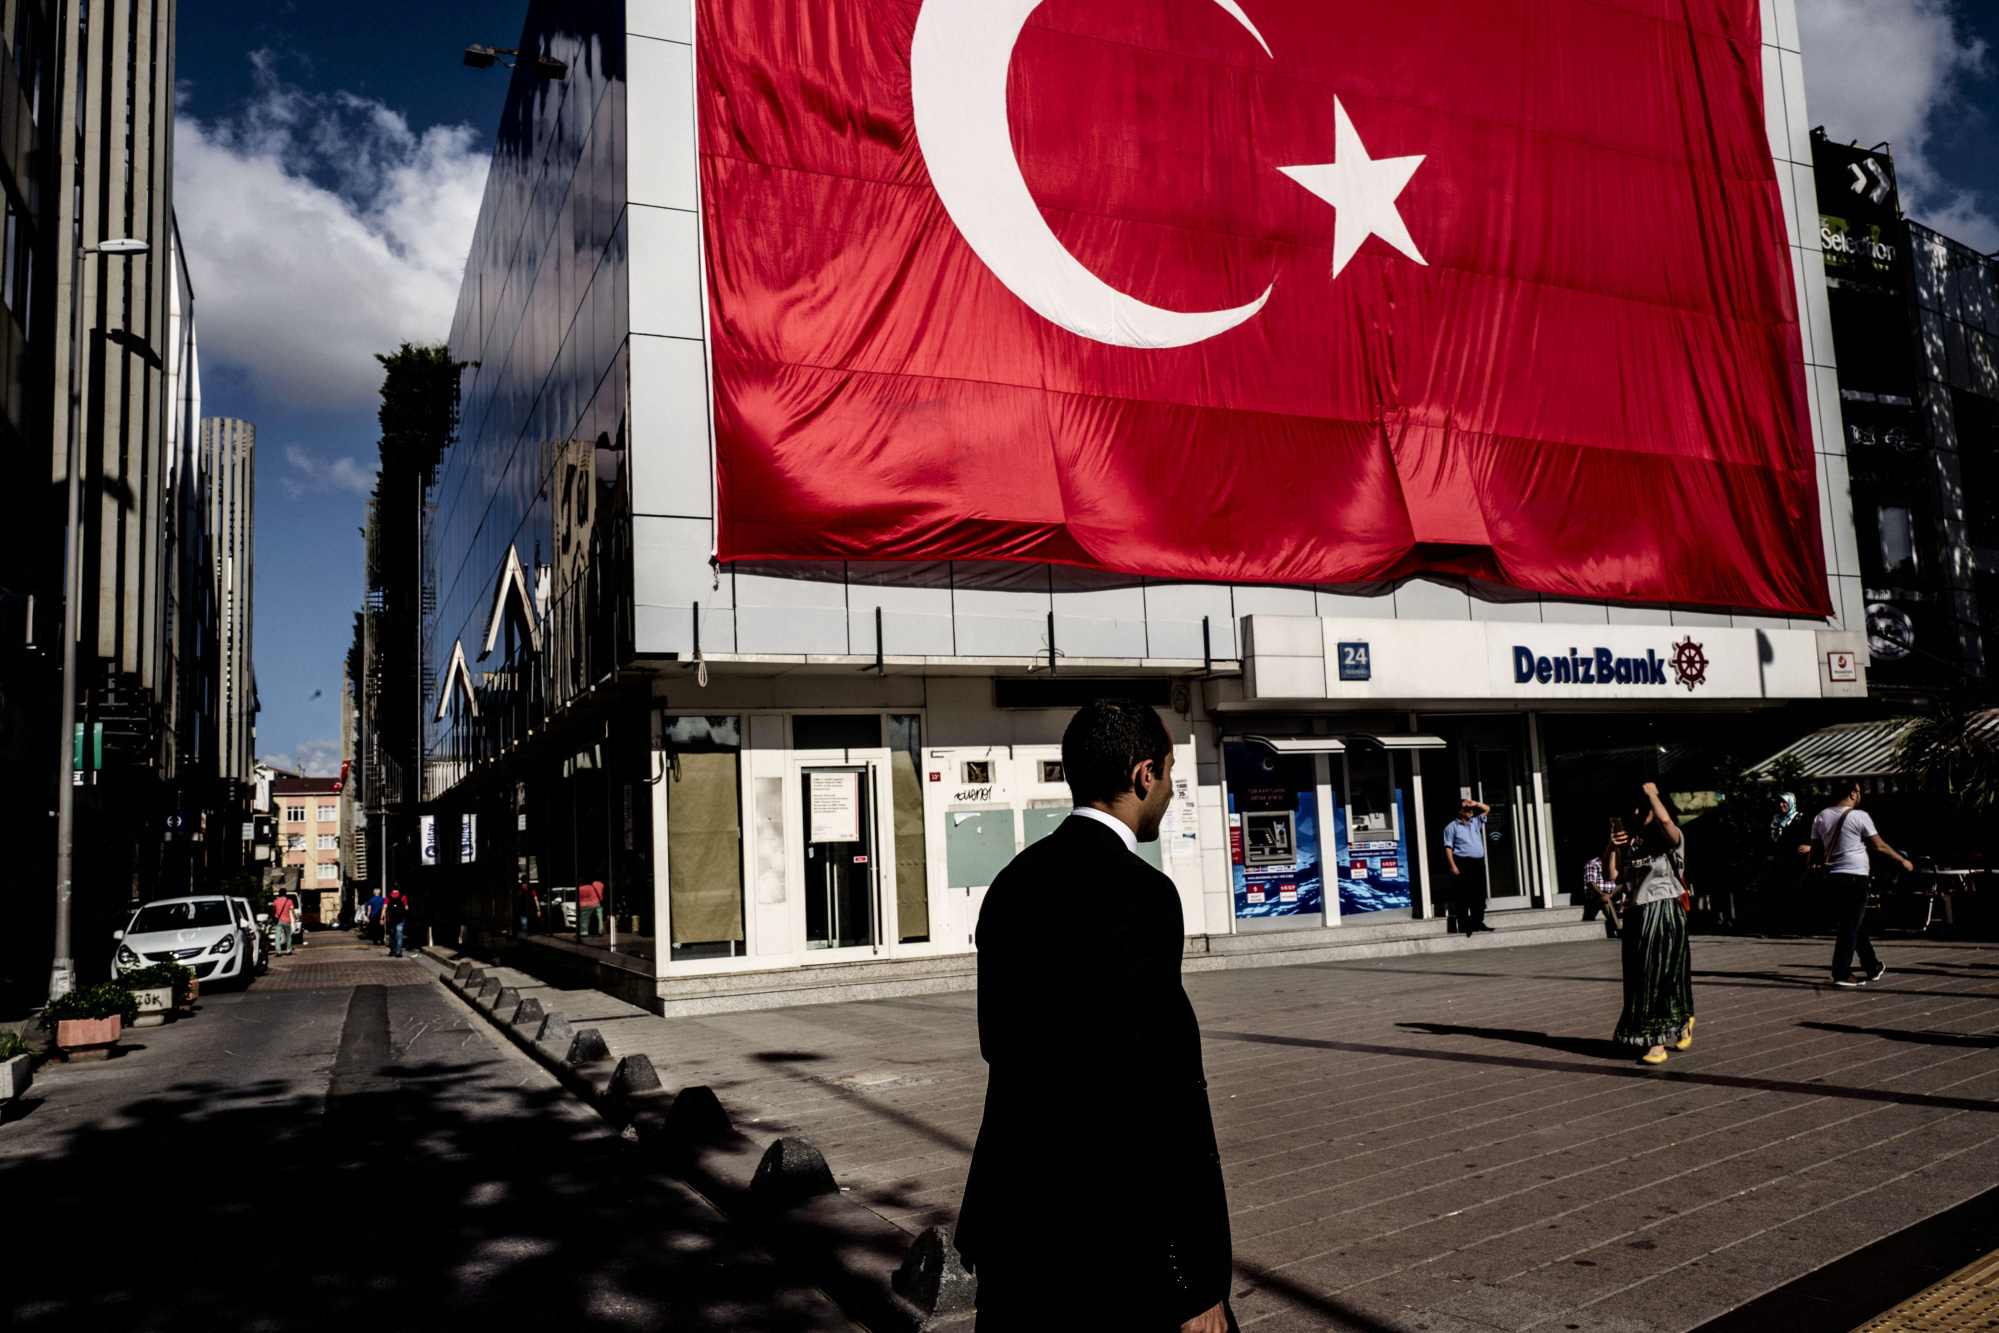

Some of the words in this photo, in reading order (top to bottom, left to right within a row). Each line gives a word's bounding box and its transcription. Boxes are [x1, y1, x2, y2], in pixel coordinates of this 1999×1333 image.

[1820, 228, 1896, 261] Selection
[1344, 647, 1367, 665] 24
[1513, 646, 1666, 684] DenizBank
